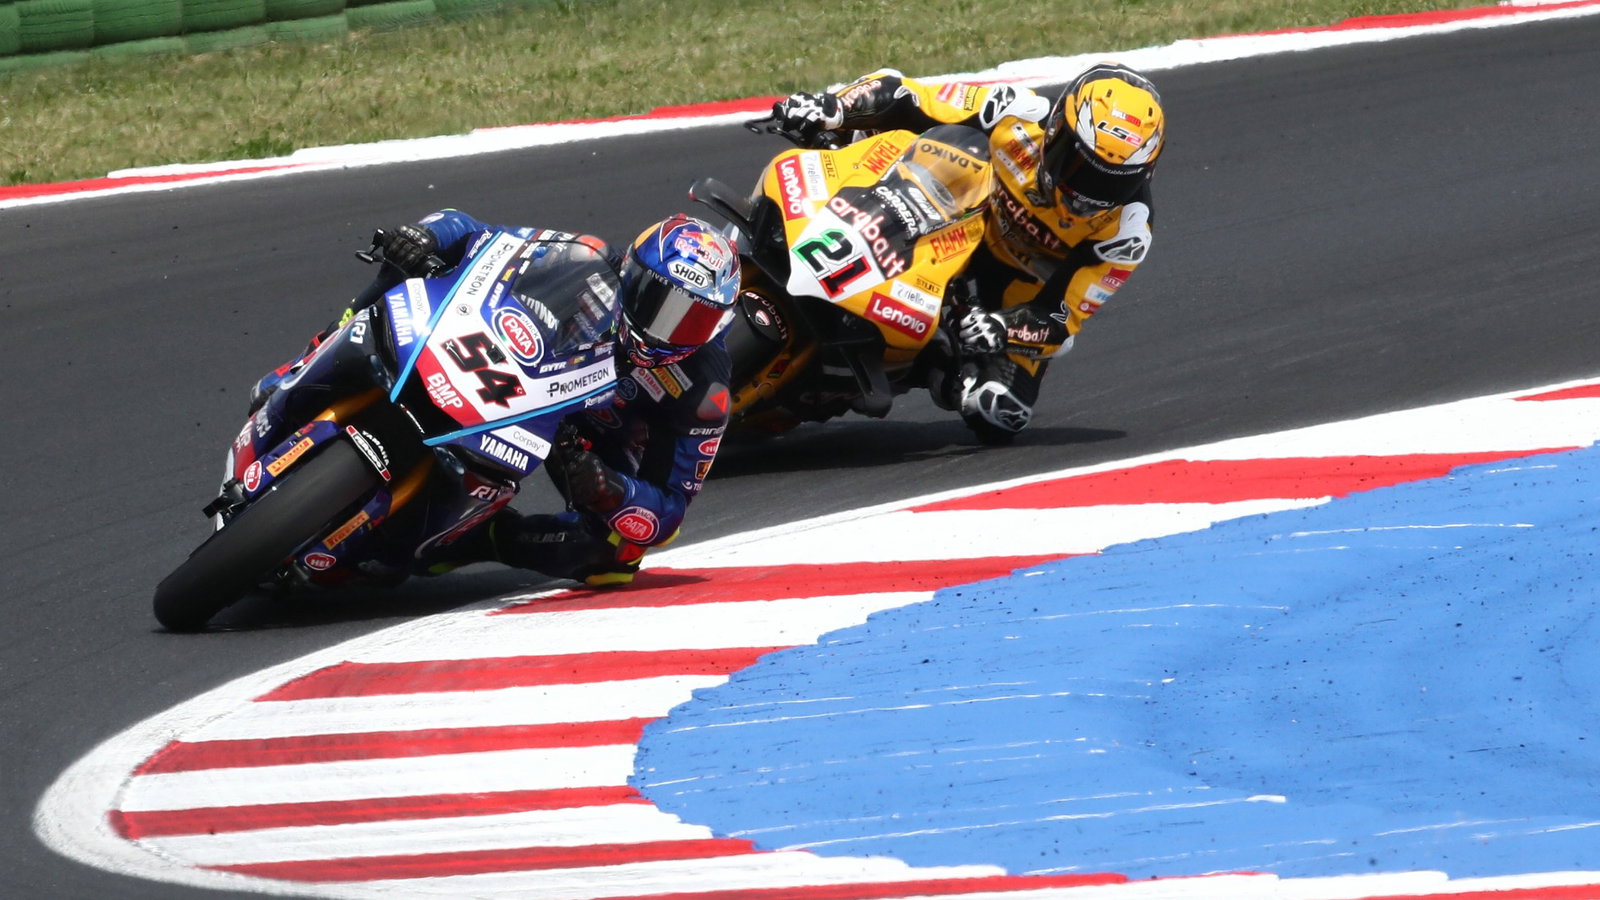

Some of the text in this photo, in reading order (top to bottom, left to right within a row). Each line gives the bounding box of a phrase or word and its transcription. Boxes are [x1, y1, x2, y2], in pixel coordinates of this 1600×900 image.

[1096, 120, 1143, 148] LS2
[863, 139, 901, 176] FIAMM
[920, 143, 970, 169] DAIKO
[781, 159, 802, 214] Lenovo
[830, 195, 905, 279] aruba.it
[929, 226, 967, 259] FIAMM
[672, 263, 705, 287] SHOEI
[791, 228, 872, 299] 21
[388, 292, 414, 347] YAMAHA
[872, 298, 926, 334] Lenovo
[505, 318, 531, 353] PATA
[440, 331, 526, 408] 54
[546, 367, 609, 397] PROMETEON
[427, 372, 464, 409] BMP
[479, 434, 529, 471] YAMAHA
[619, 517, 648, 536] PATA
